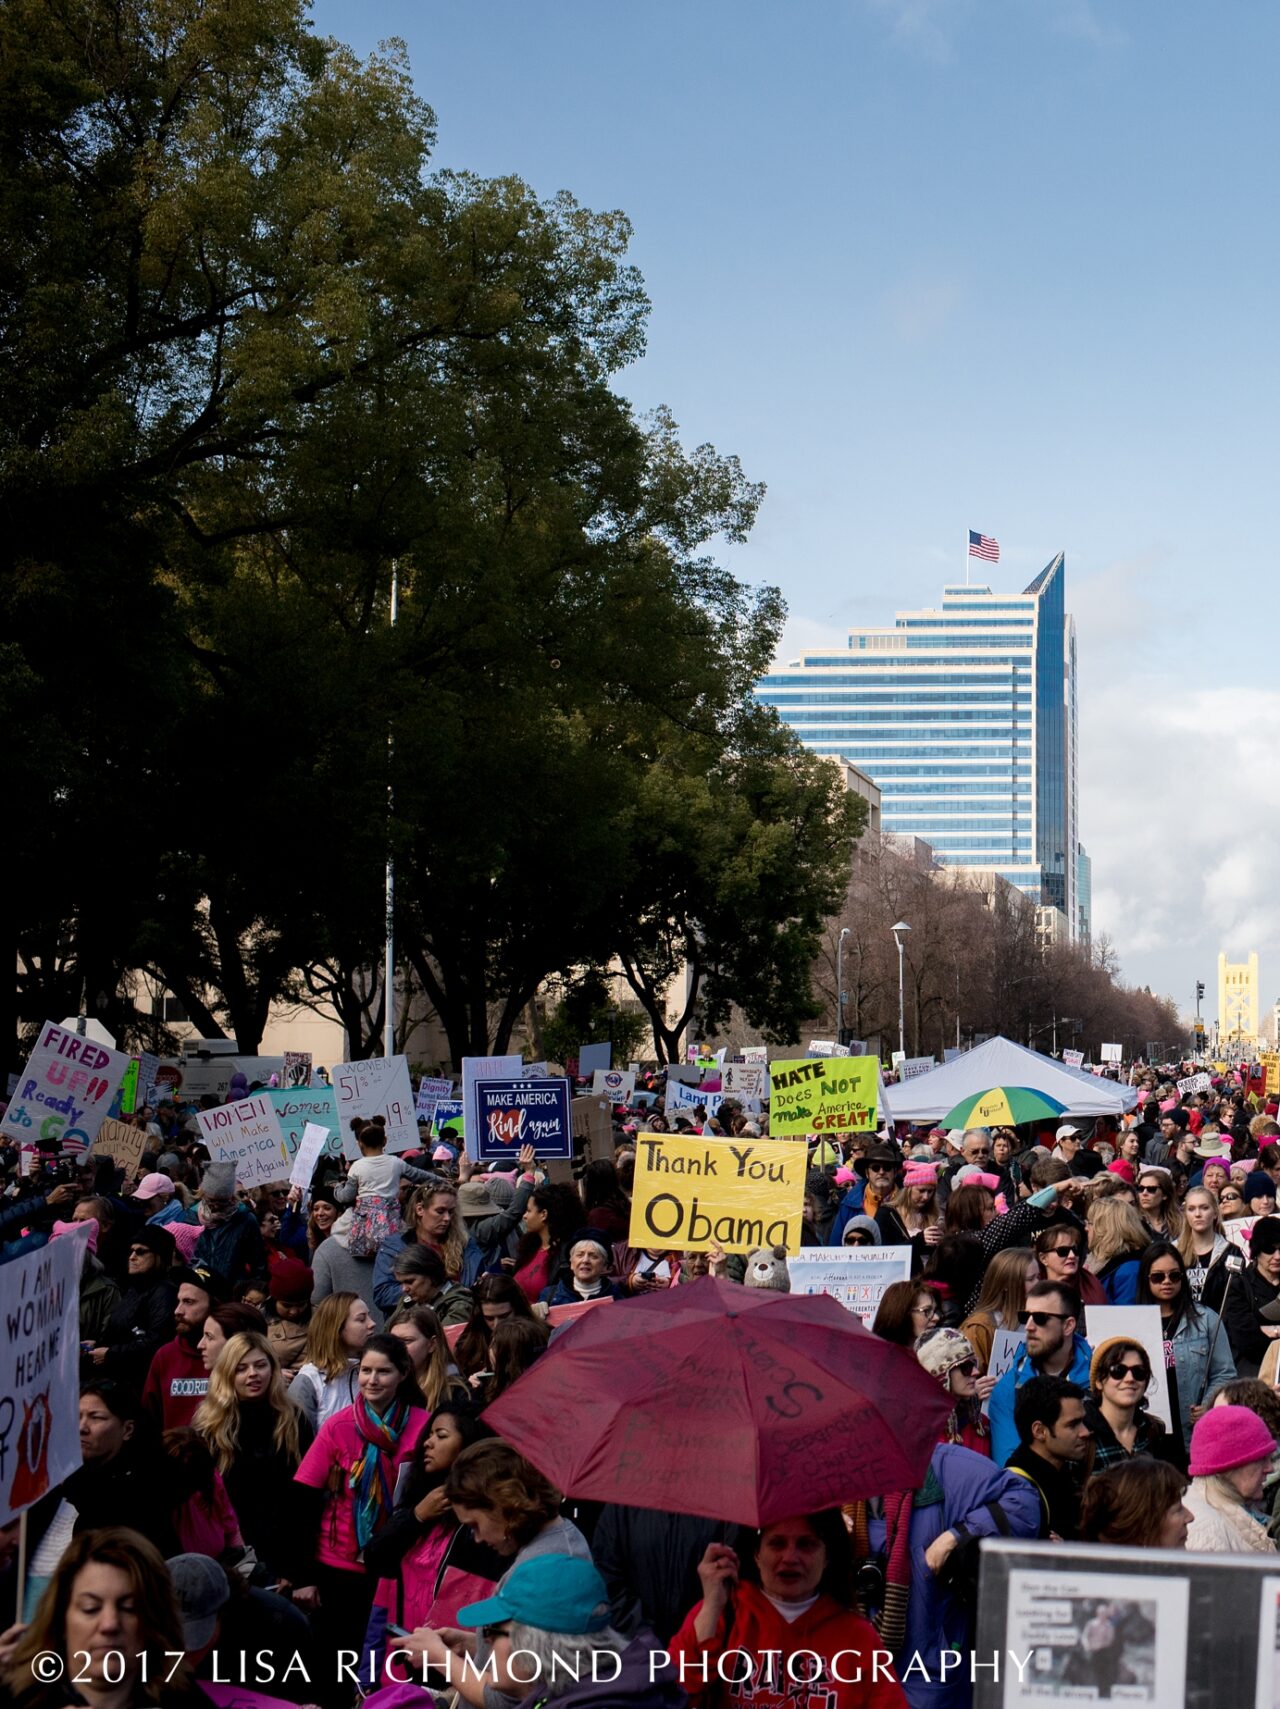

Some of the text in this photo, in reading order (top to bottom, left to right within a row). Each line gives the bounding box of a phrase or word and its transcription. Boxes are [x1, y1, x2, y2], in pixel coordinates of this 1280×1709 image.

[43, 1028, 110, 1070] FIRED
[344, 1059, 392, 1074] WOMEN
[772, 1061, 826, 1090] HATE
[46, 1060, 109, 1104] UP!!
[422, 1083, 450, 1094] Dignity
[680, 1087, 708, 1106] Land
[821, 1076, 861, 1096] NOT
[21, 1079, 84, 1127] Ready
[487, 1092, 558, 1106] MAKE AMERICA
[818, 1101, 866, 1115] America
[203, 1099, 266, 1131] WOMEN
[240, 1122, 270, 1138] Make
[486, 1108, 562, 1143] Kind again
[812, 1107, 875, 1130] GREAT!
[220, 1138, 275, 1160] America
[640, 1140, 790, 1186] Thank You,
[645, 1192, 790, 1250] Obama
[21, 1258, 52, 1299] I AM
[6, 1278, 65, 1344] WOMAN
[15, 1327, 60, 1388] HEAR ME
